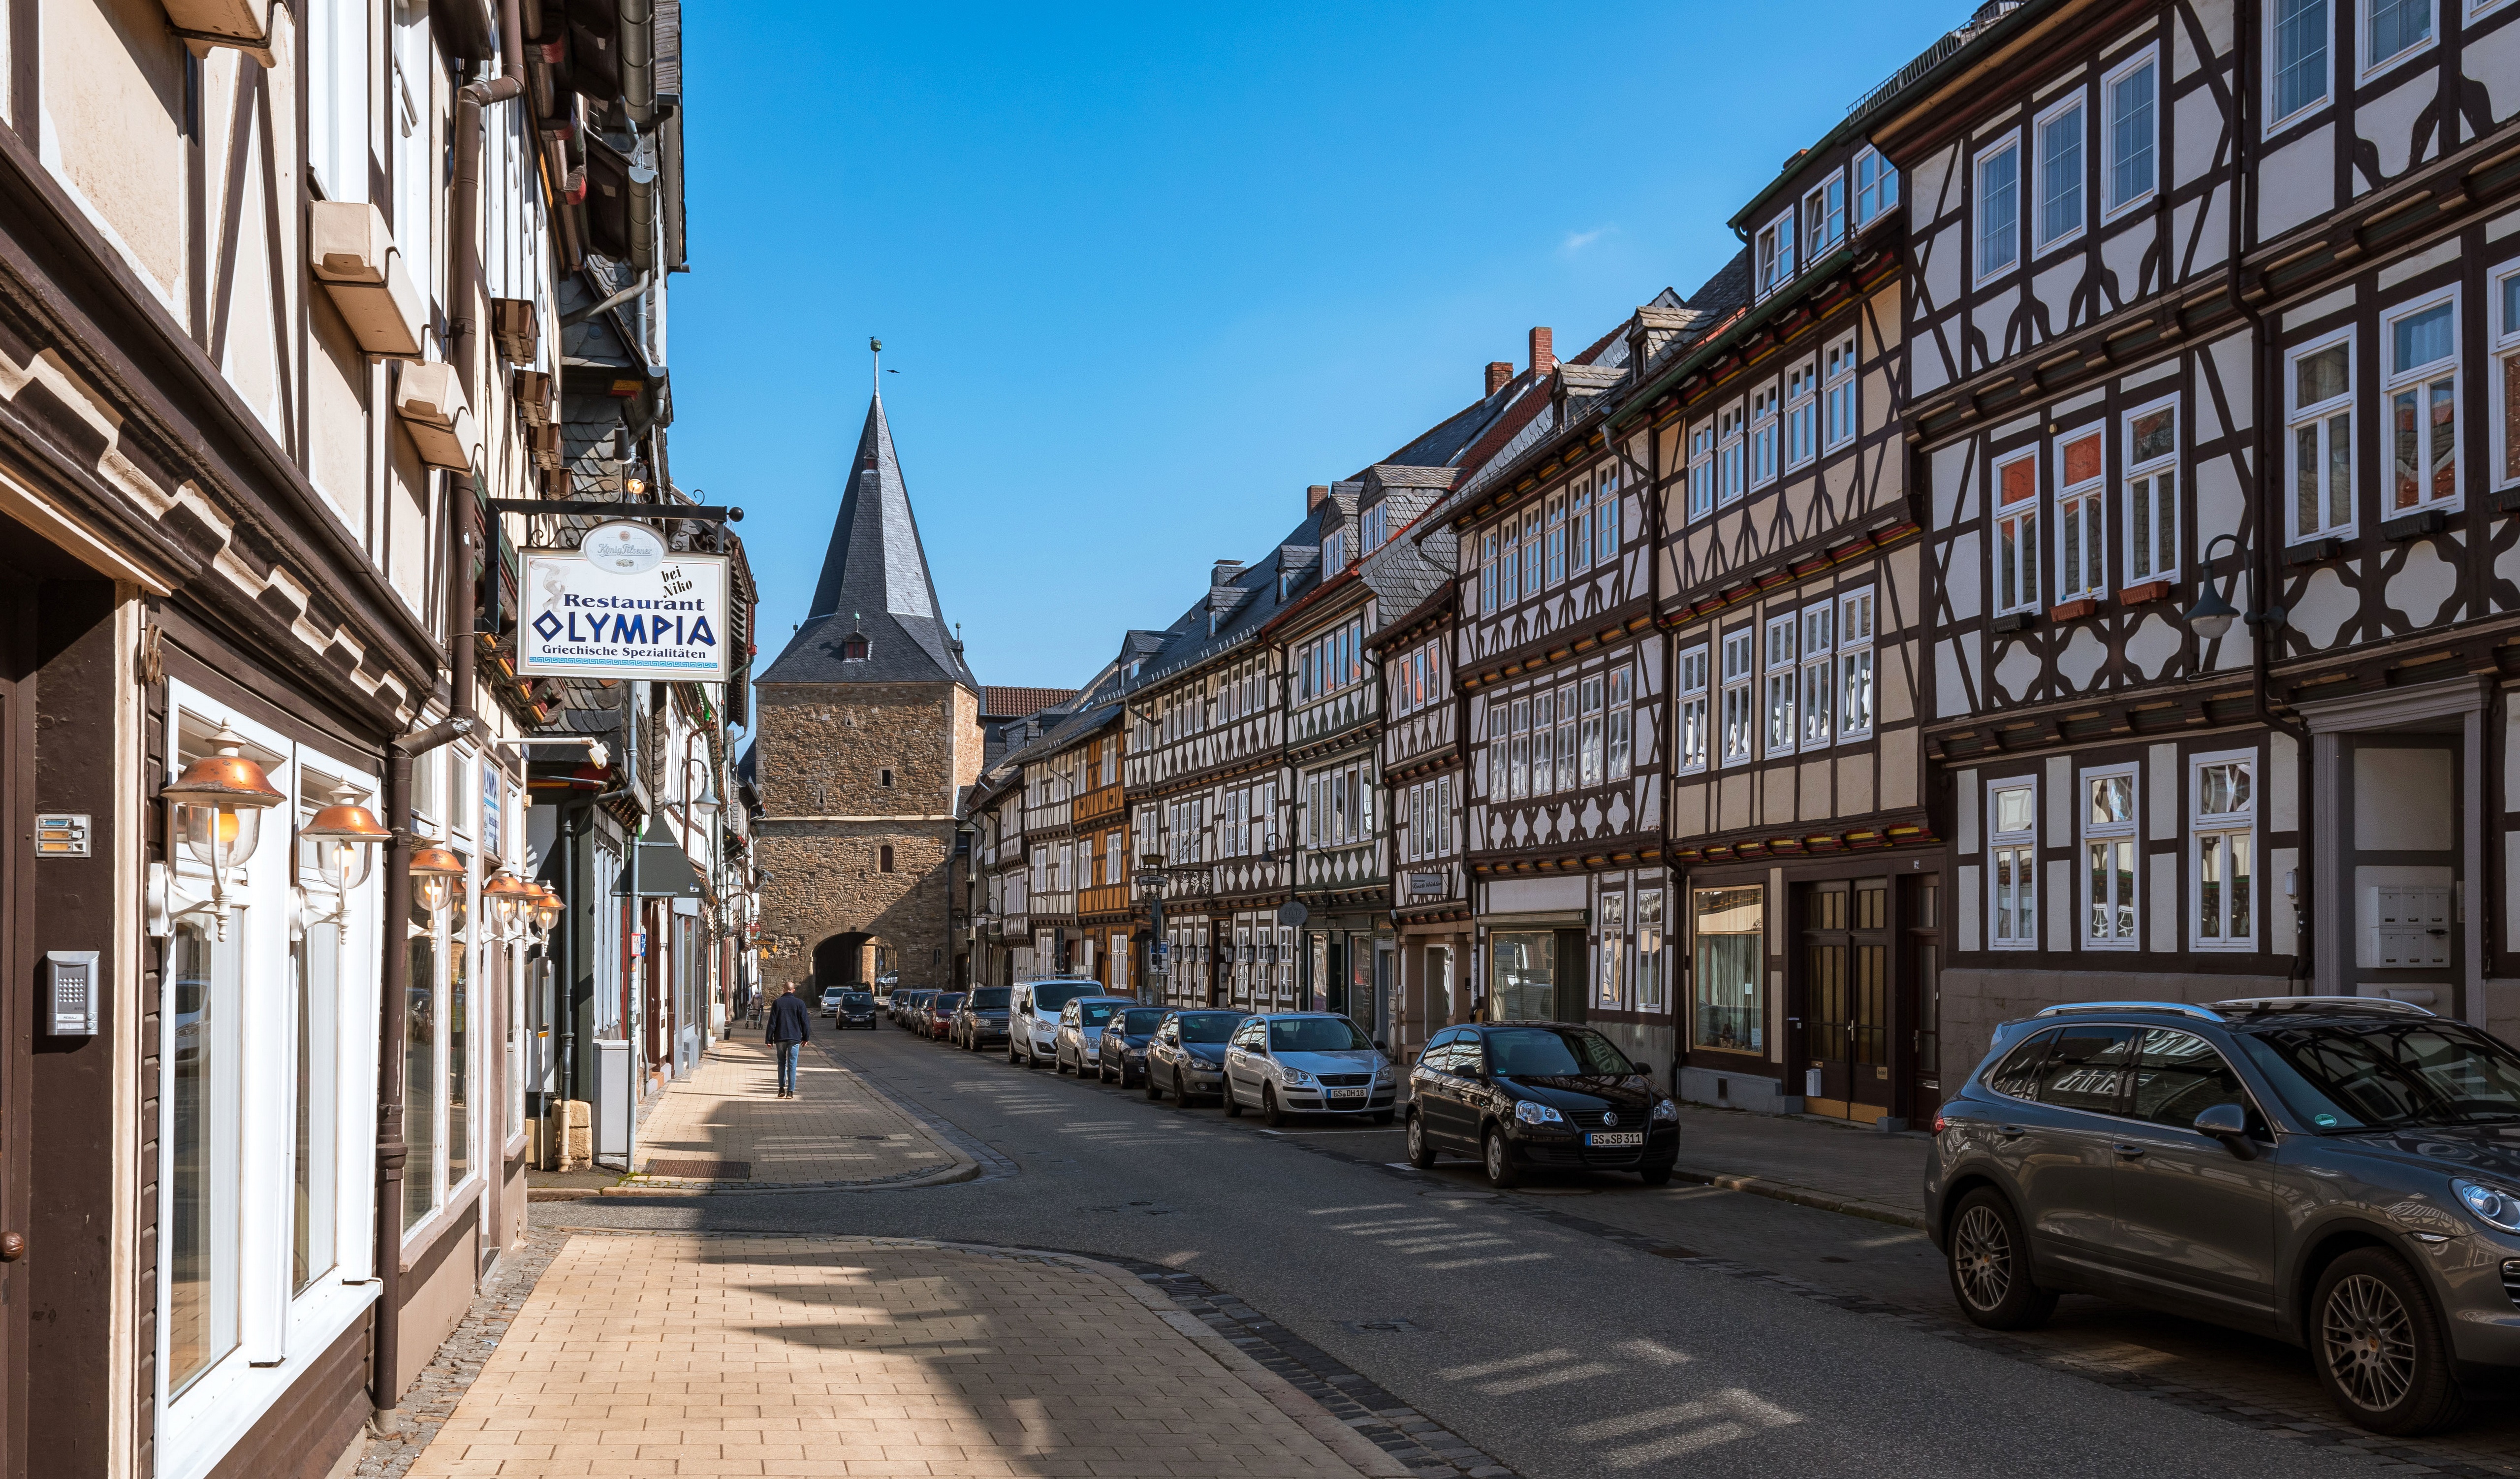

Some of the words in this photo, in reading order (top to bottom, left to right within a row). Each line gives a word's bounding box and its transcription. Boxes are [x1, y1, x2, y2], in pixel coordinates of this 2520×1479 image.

[598, 543, 622, 556] König
[621, 544, 653, 555] Pilsener
[661, 565, 682, 582] bei
[662, 580, 693, 598] Niko
[564, 594, 705, 611] Restaurant
[532, 609, 717, 647] OLYMPIA
[542, 644, 618, 656] Griechische
[622, 647, 706, 659] Spezialitäten
[1592, 1134, 1605, 1144] GS
[1610, 1134, 1622, 1144] SB
[1624, 1133, 1641, 1144] 311
